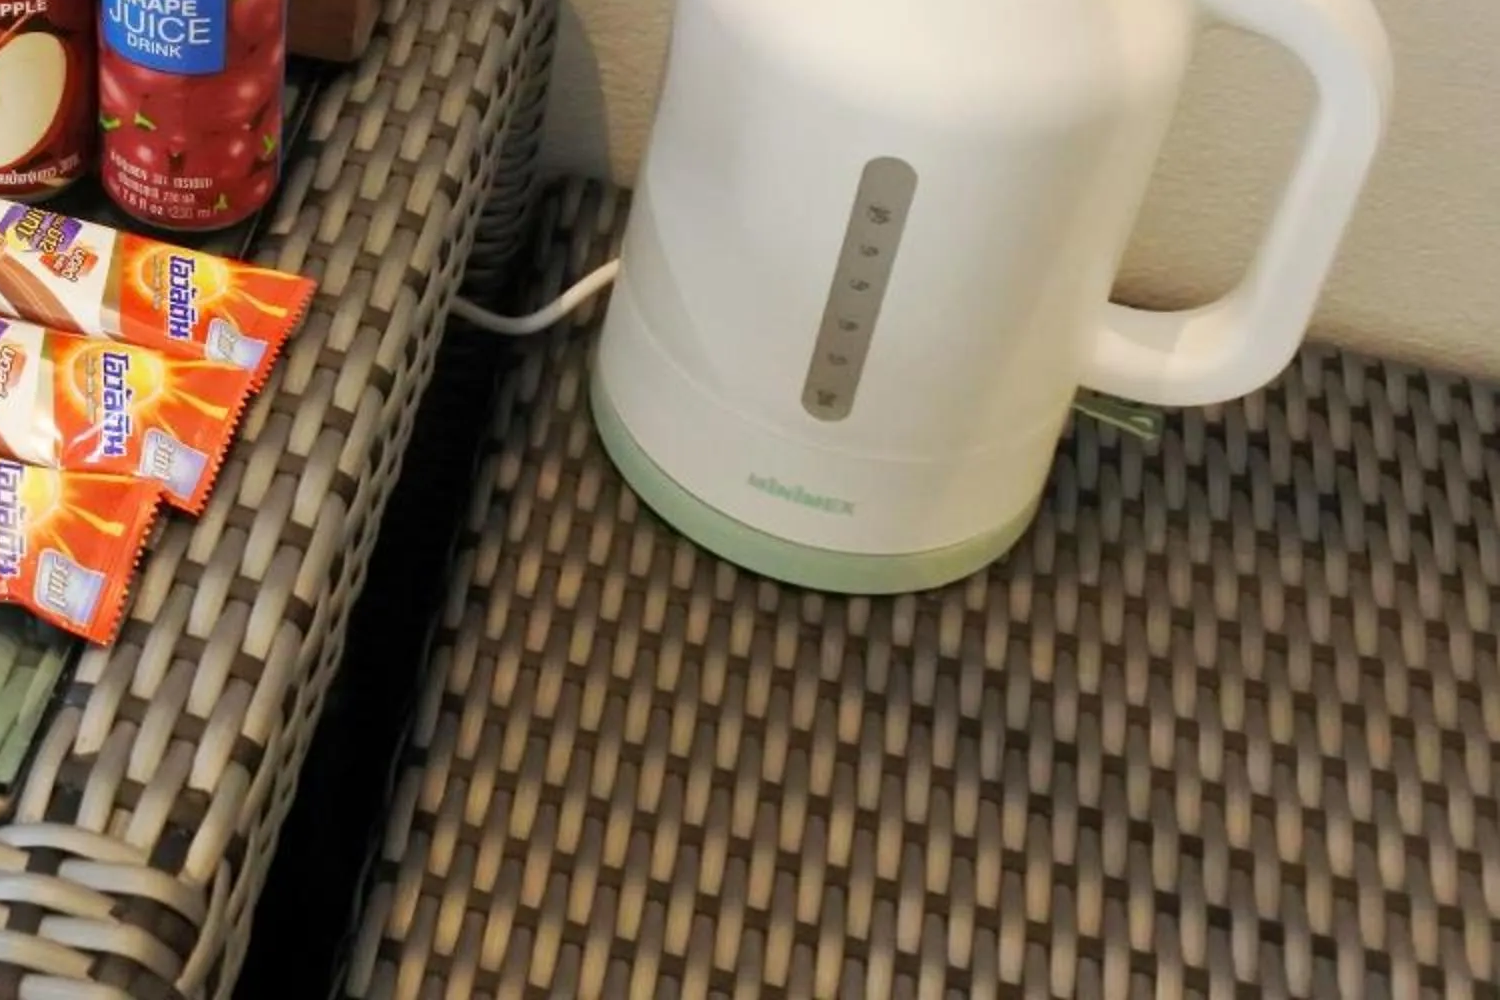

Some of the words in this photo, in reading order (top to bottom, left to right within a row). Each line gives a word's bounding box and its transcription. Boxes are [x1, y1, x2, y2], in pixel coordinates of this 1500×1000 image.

[127, 32, 182, 58] DRINK
[169, 255, 198, 338] โอวัลติน
[103, 352, 133, 456] โอวัลติน
